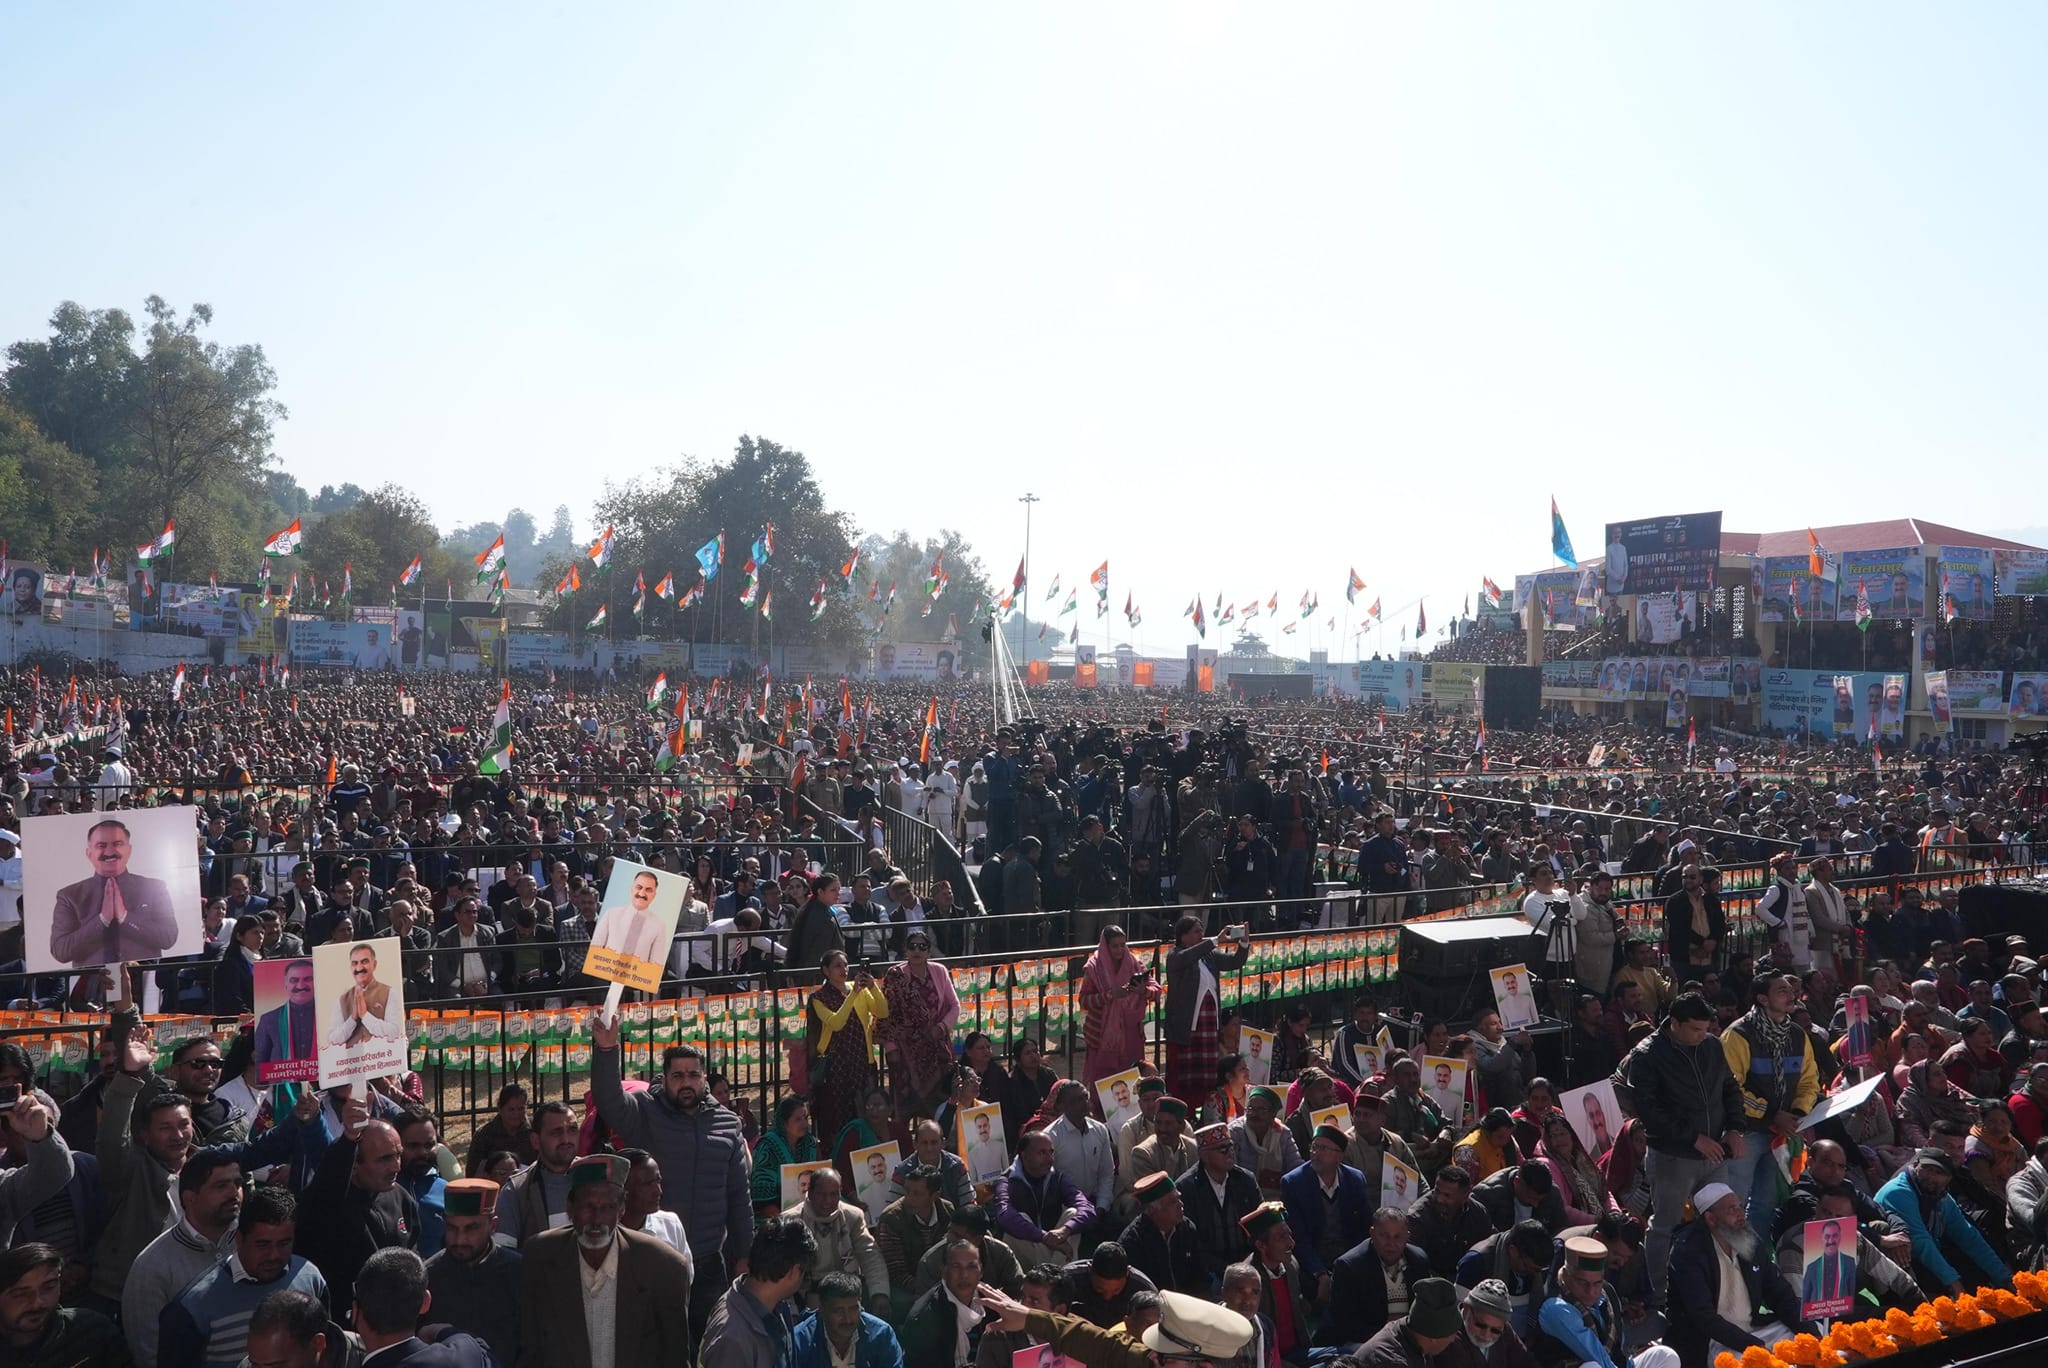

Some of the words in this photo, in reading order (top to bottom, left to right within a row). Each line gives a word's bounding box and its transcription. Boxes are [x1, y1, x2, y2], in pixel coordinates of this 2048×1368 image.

[300, 1060, 318, 1069] हिमा
[336, 1055, 360, 1066] व्यवस्था
[361, 1051, 385, 1062] परिवर्तन
[386, 1050, 392, 1058] से
[265, 1068, 307, 1079] आत्मनिर्भर
[327, 1067, 362, 1080] आत्मनिर्भर
[363, 1064, 376, 1073] होता
[377, 1059, 402, 1070] हिमाचल
